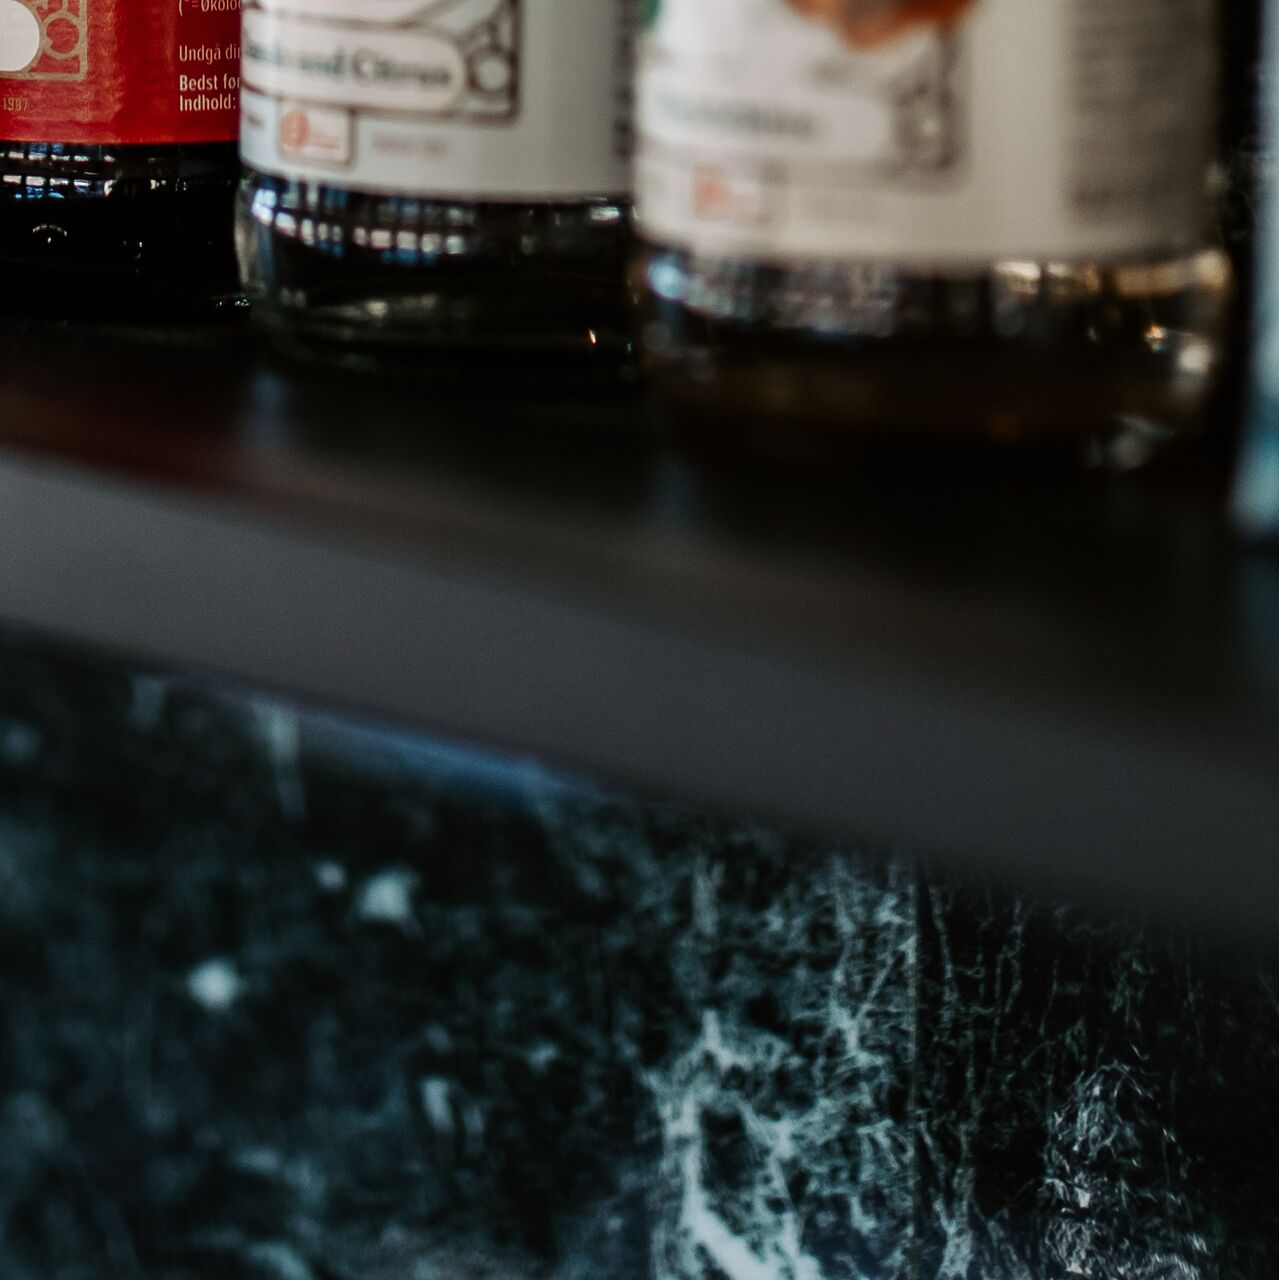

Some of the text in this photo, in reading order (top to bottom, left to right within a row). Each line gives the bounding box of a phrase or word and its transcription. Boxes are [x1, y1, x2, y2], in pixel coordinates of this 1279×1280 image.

[179, 43, 221, 65] Undgå
[179, 73, 218, 92] Bedst
[179, 92, 236, 112] Indhold:
